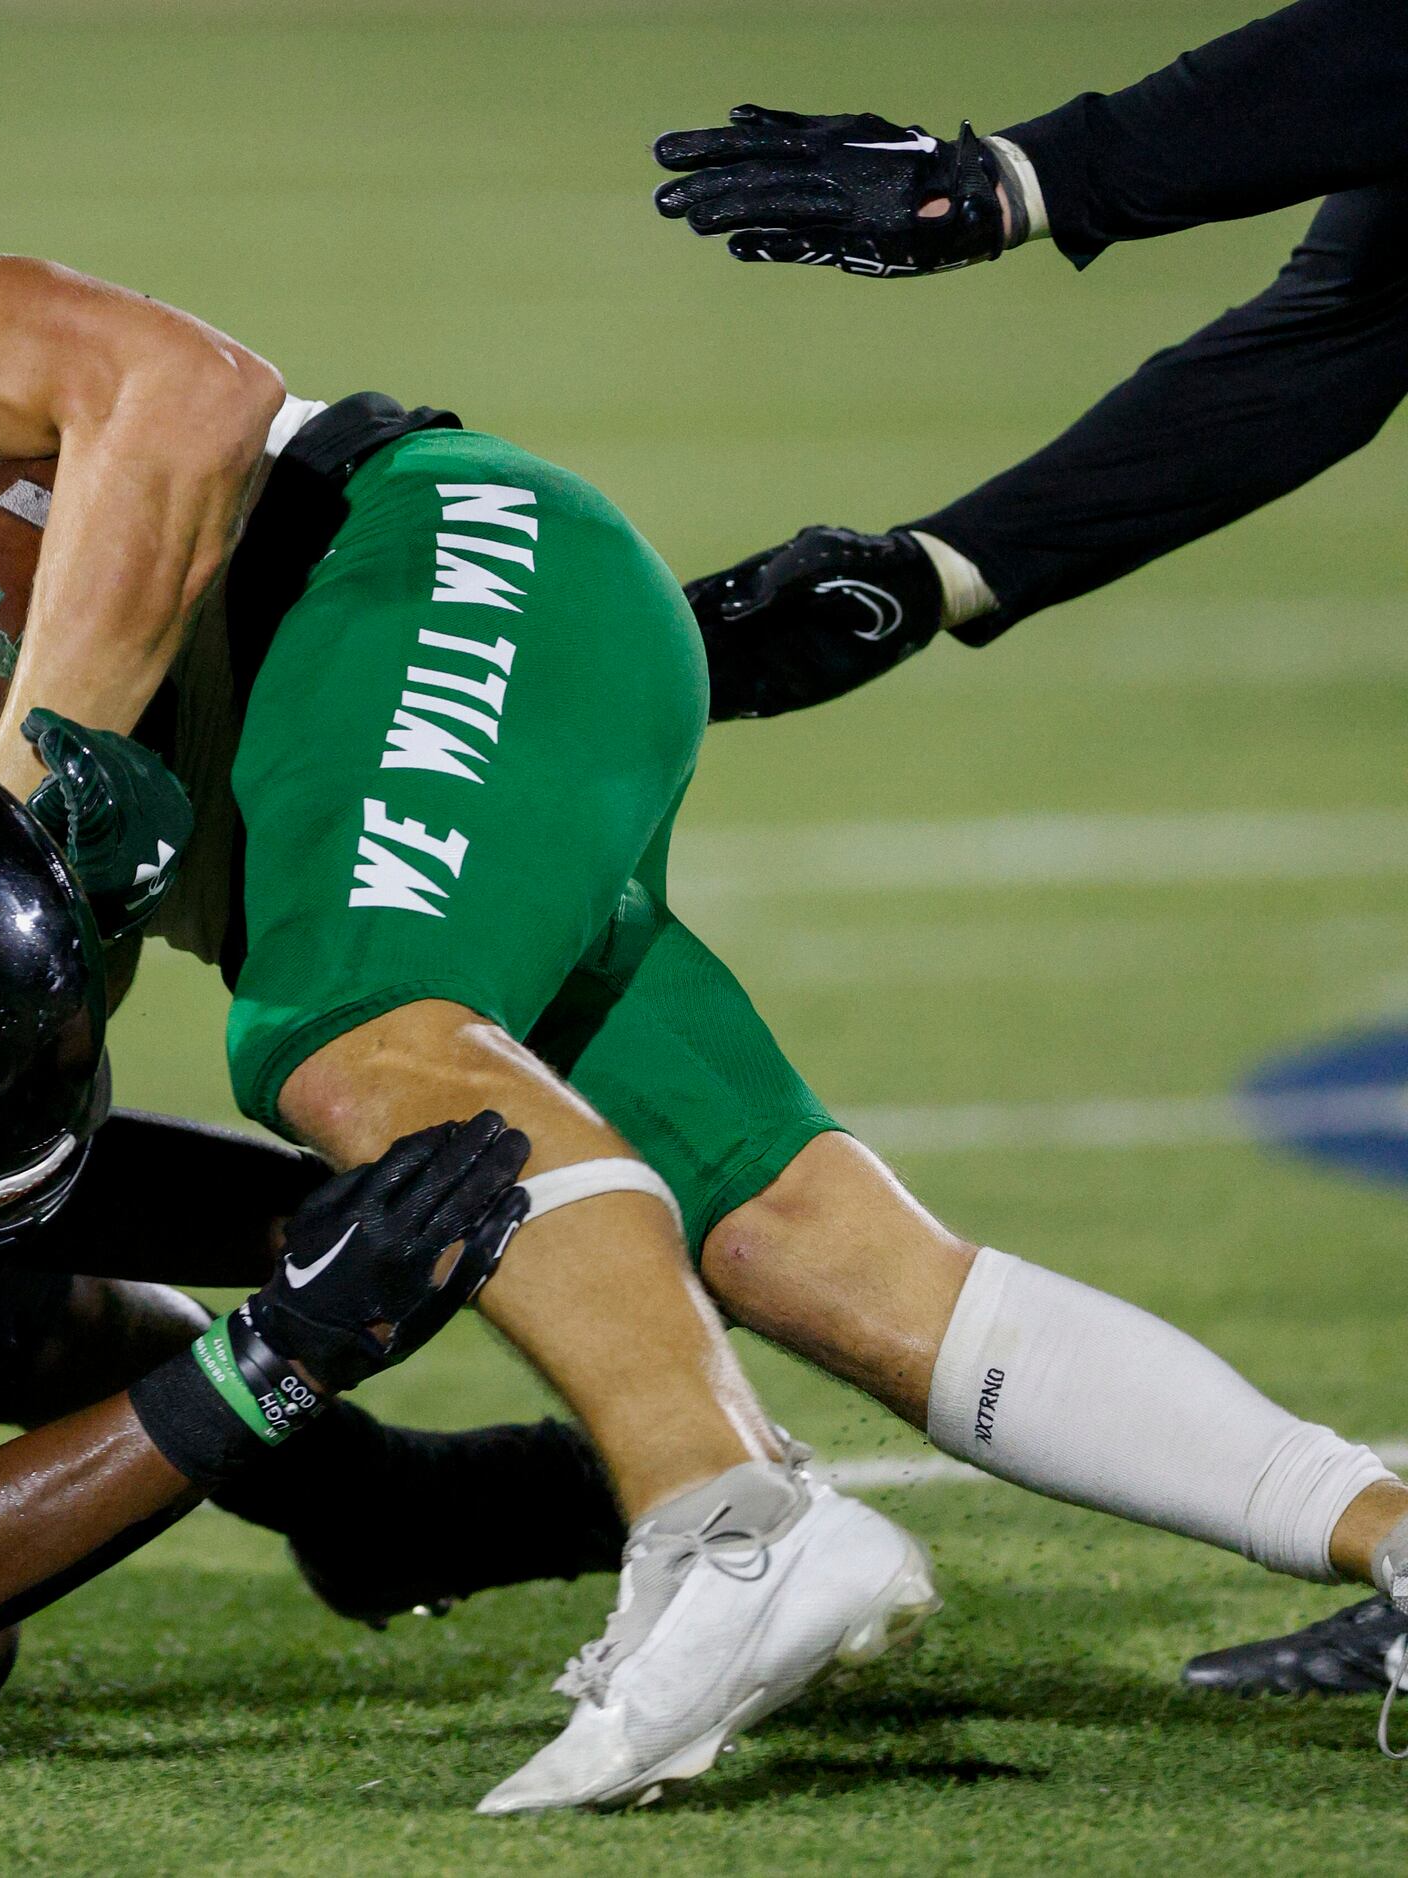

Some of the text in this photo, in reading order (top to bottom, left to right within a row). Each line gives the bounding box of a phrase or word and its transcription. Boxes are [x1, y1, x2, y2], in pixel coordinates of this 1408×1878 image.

[348, 483, 539, 918] WE WILL WIN
[280, 1375, 317, 1409] GOD
